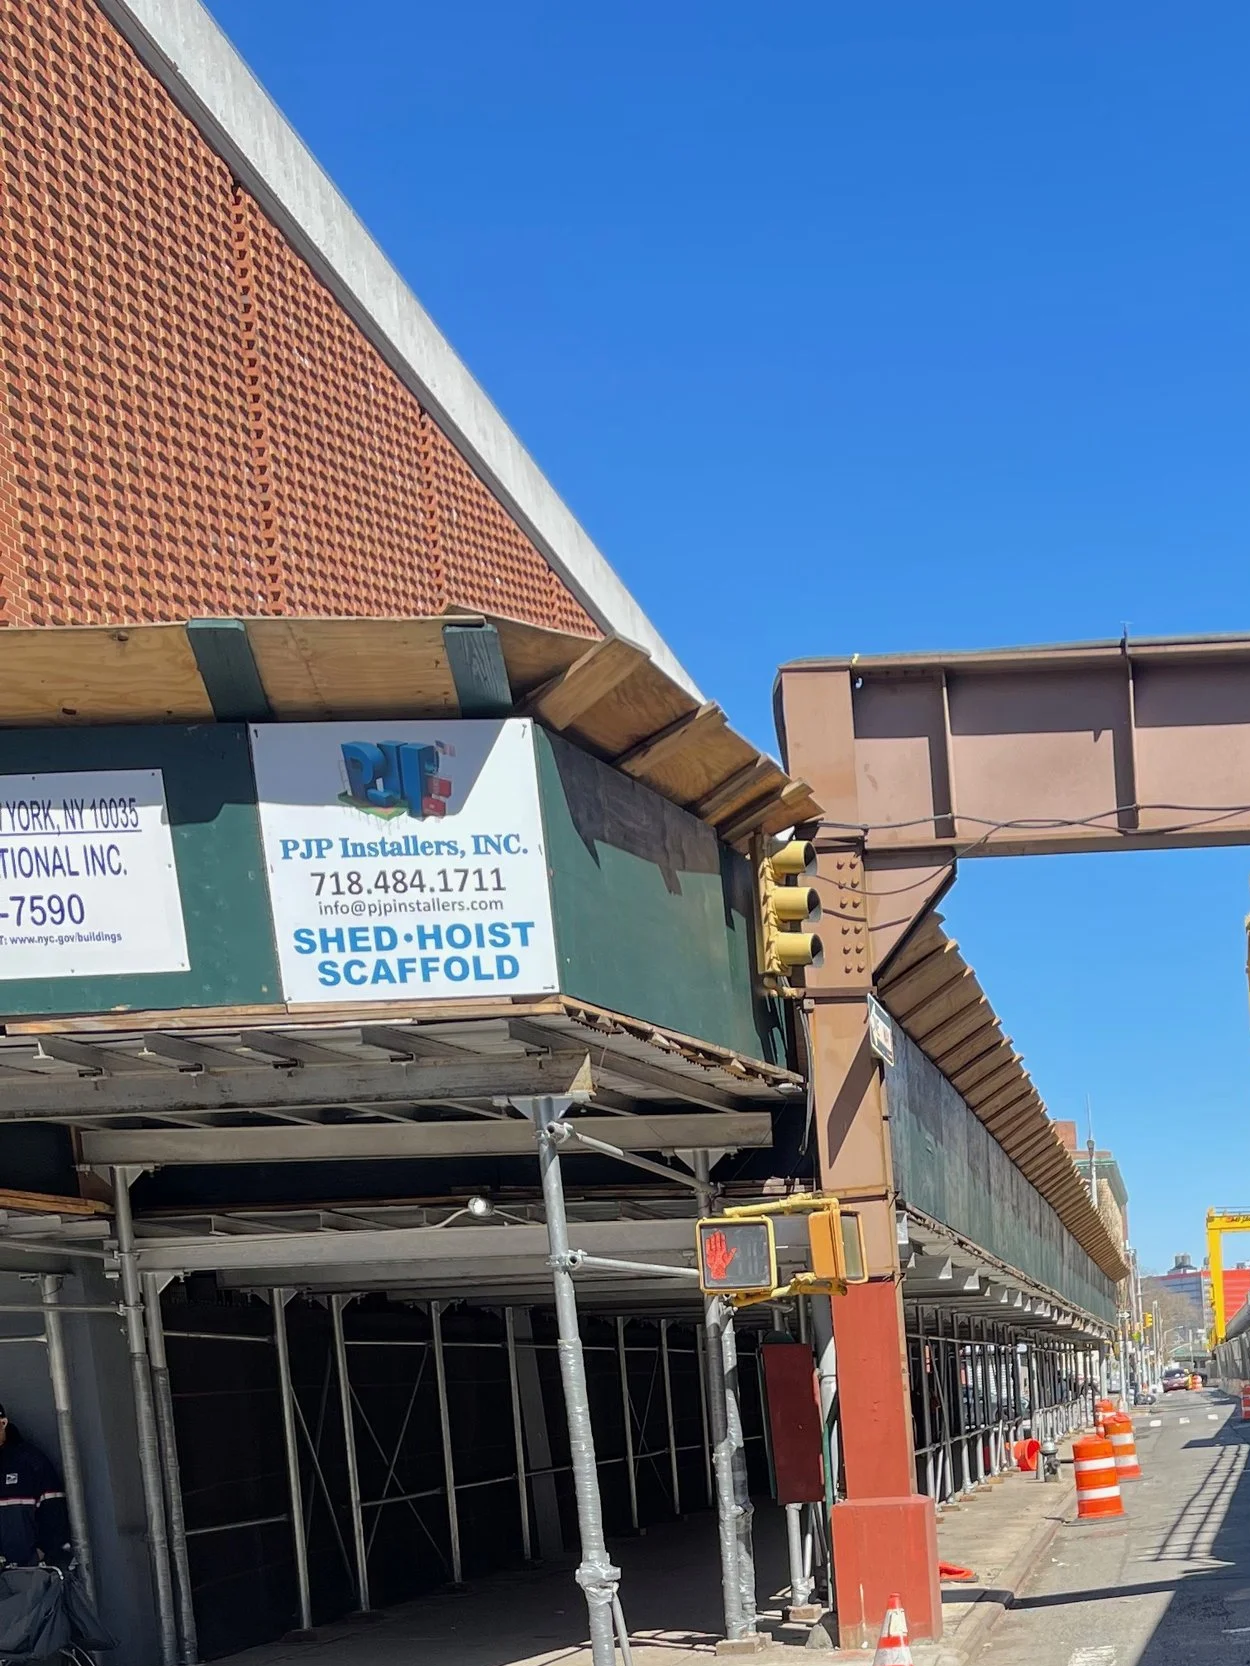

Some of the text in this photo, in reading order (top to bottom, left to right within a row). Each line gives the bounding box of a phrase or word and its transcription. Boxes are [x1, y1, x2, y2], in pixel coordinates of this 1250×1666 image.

[6, 799, 61, 837] YORK,
[63, 799, 85, 830] NY
[90, 797, 139, 829] 10035
[83, 843, 127, 877] INC.
[279, 833, 529, 860] PJP Installers, INC.
[310, 867, 507, 897] 718.484.1711
[318, 897, 504, 917] info@pjpinstallers.com
[9, 931, 122, 946] www.nyc.gov/buildings
[317, 954, 520, 987] SCAFFOLD
